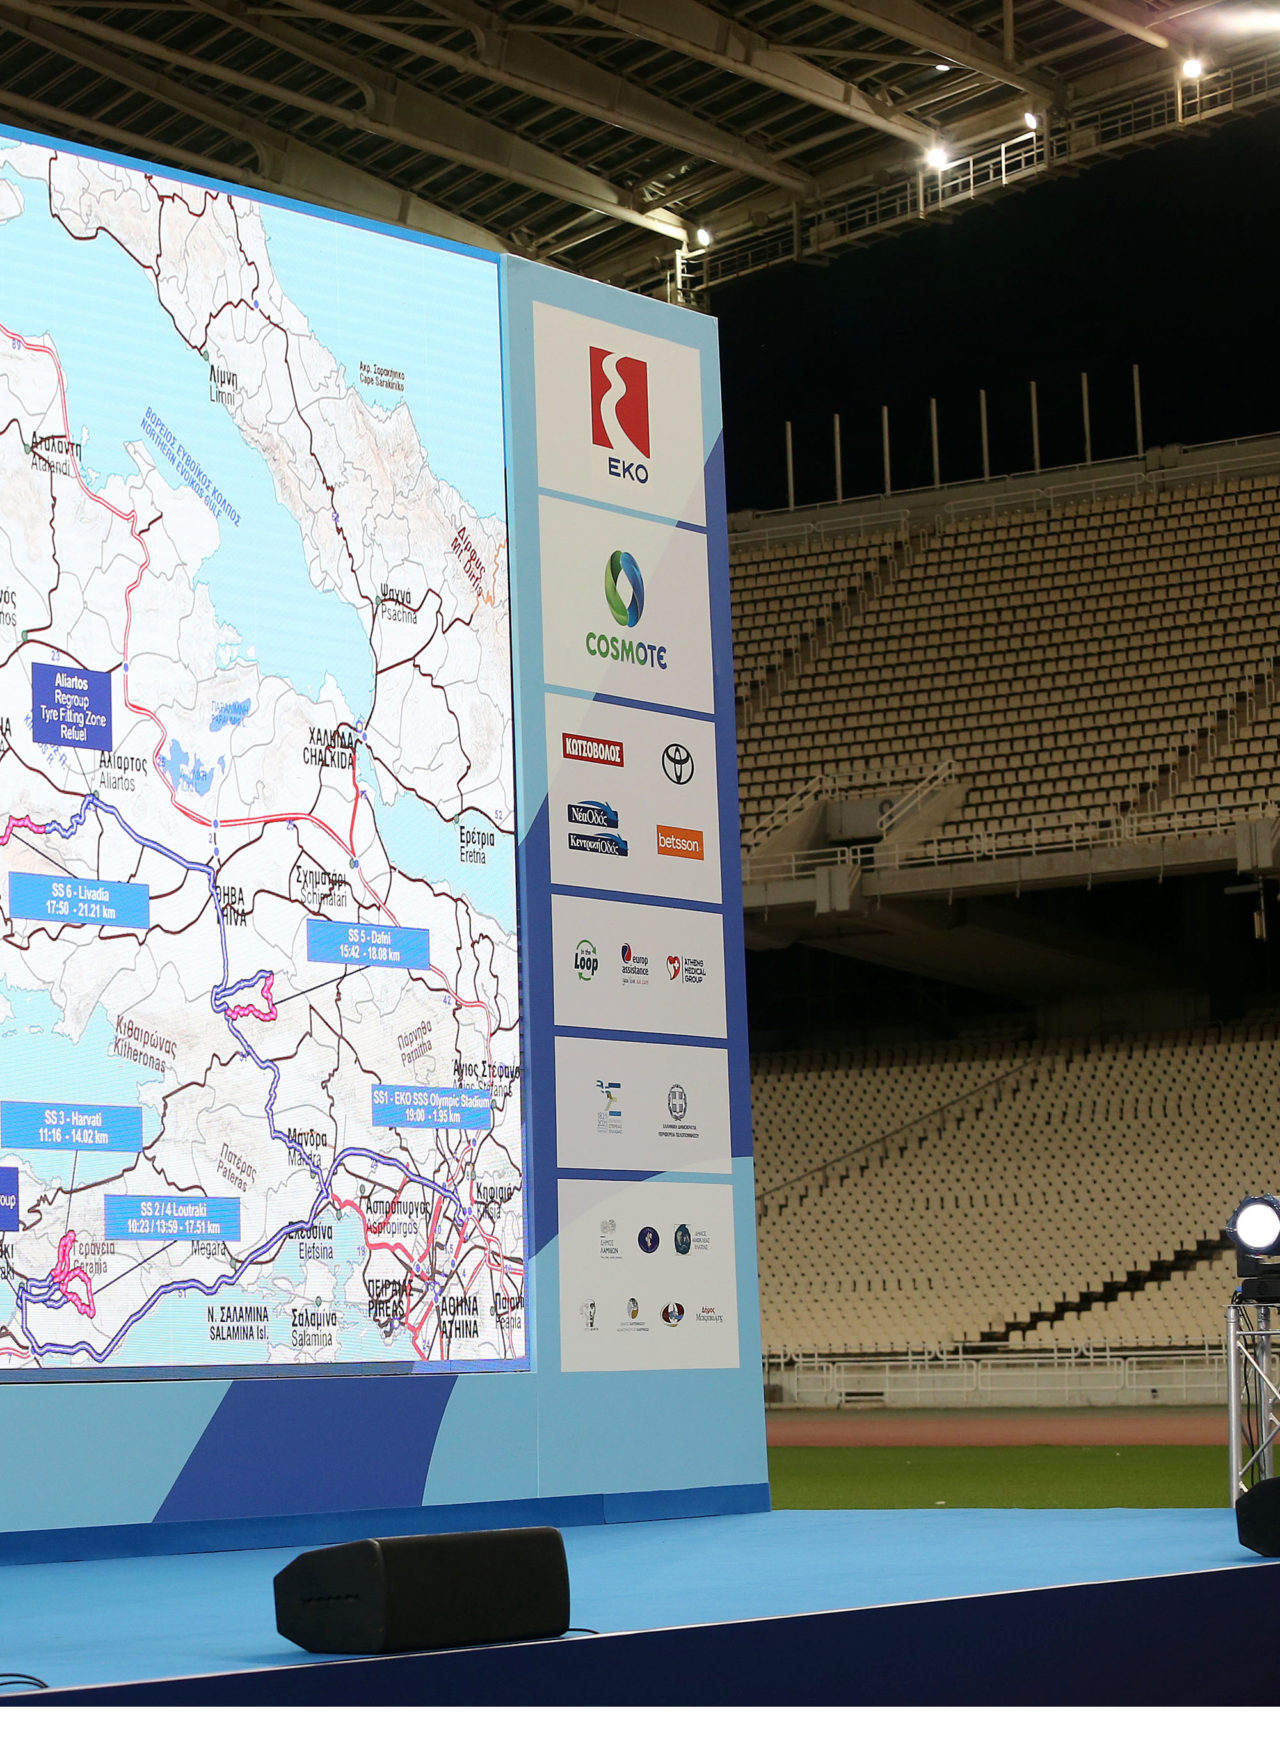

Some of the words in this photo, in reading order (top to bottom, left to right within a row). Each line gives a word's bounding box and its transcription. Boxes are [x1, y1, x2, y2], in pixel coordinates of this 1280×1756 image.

[209, 364, 238, 392] Λίμνη
[209, 385, 235, 406] Limni
[140, 417, 176, 463] NORTHERN
[608, 456, 649, 484] EKO
[381, 603, 417, 624] Psachna
[586, 632, 668, 670] COSMOTE
[55, 673, 89, 690] Aliartos
[55, 690, 90, 708] Regroup
[40, 705, 59, 722] Tyre
[59, 709, 85, 727] Filling
[86, 713, 107, 727] Zone
[60, 725, 87, 742] Refuel
[303, 748, 354, 771] CHALKIDA
[565, 737, 621, 763] ΚΩΤΣΟΒΟΛΟΣ
[99, 771, 136, 792] Aliartos
[459, 826, 495, 849] Ερέτρια
[659, 833, 699, 852] betsson
[460, 846, 486, 865] Eretria
[52, 883, 66, 898] SS
[79, 886, 110, 902] Livadia
[301, 887, 347, 908] Schimatari
[46, 902, 69, 916] 17:50
[78, 904, 101, 918] 21.21
[102, 905, 116, 919] km
[348, 928, 360, 943] SS
[371, 931, 391, 944] Dafni
[340, 944, 360, 958] 15:42
[388, 948, 400, 961] km
[633, 956, 649, 966] europ
[575, 952, 598, 976] Loop
[622, 965, 649, 976] assistance
[684, 958, 704, 967] ATHENS
[684, 967, 707, 976] MEDICAL
[685, 976, 703, 984] GROUP
[116, 1015, 178, 1061] Κιθαιρώνας
[113, 1037, 166, 1073] Kitheronas
[401, 1040, 432, 1067] Parnitha
[374, 1091, 388, 1104] SS1
[395, 1092, 411, 1105] EKO
[414, 1093, 428, 1105] SSS
[430, 1094, 459, 1109] Olympic
[461, 1095, 489, 1107] Stadium
[44, 1110, 58, 1126] SS
[71, 1112, 102, 1127] Harvati
[406, 1109, 425, 1121] 19:00
[433, 1110, 447, 1122] 1.95
[450, 1110, 460, 1122] km
[39, 1128, 62, 1144] 11:16
[71, 1130, 94, 1144] 14.02
[95, 1130, 109, 1145] km
[217, 1160, 249, 1193] Pateras
[140, 1204, 153, 1216] SS
[172, 1204, 207, 1217] Loutraki
[127, 1219, 151, 1234] 10:23
[156, 1220, 179, 1234] 13:59
[185, 1221, 207, 1234] 17.51
[208, 1221, 221, 1235] km
[191, 1240, 227, 1259] Megara
[299, 1242, 334, 1260] Elefsina
[220, 1307, 269, 1322] ΣΑΛΑΜΙΝΑ
[441, 1296, 479, 1317] ΑΘΗΝΑ
[292, 1308, 337, 1328] Σαλαμίνα
[209, 1326, 255, 1341] SALAMINA
[257, 1326, 269, 1340] Isl.
[292, 1329, 333, 1347] Salamina
[441, 1320, 479, 1338] ATHINA
